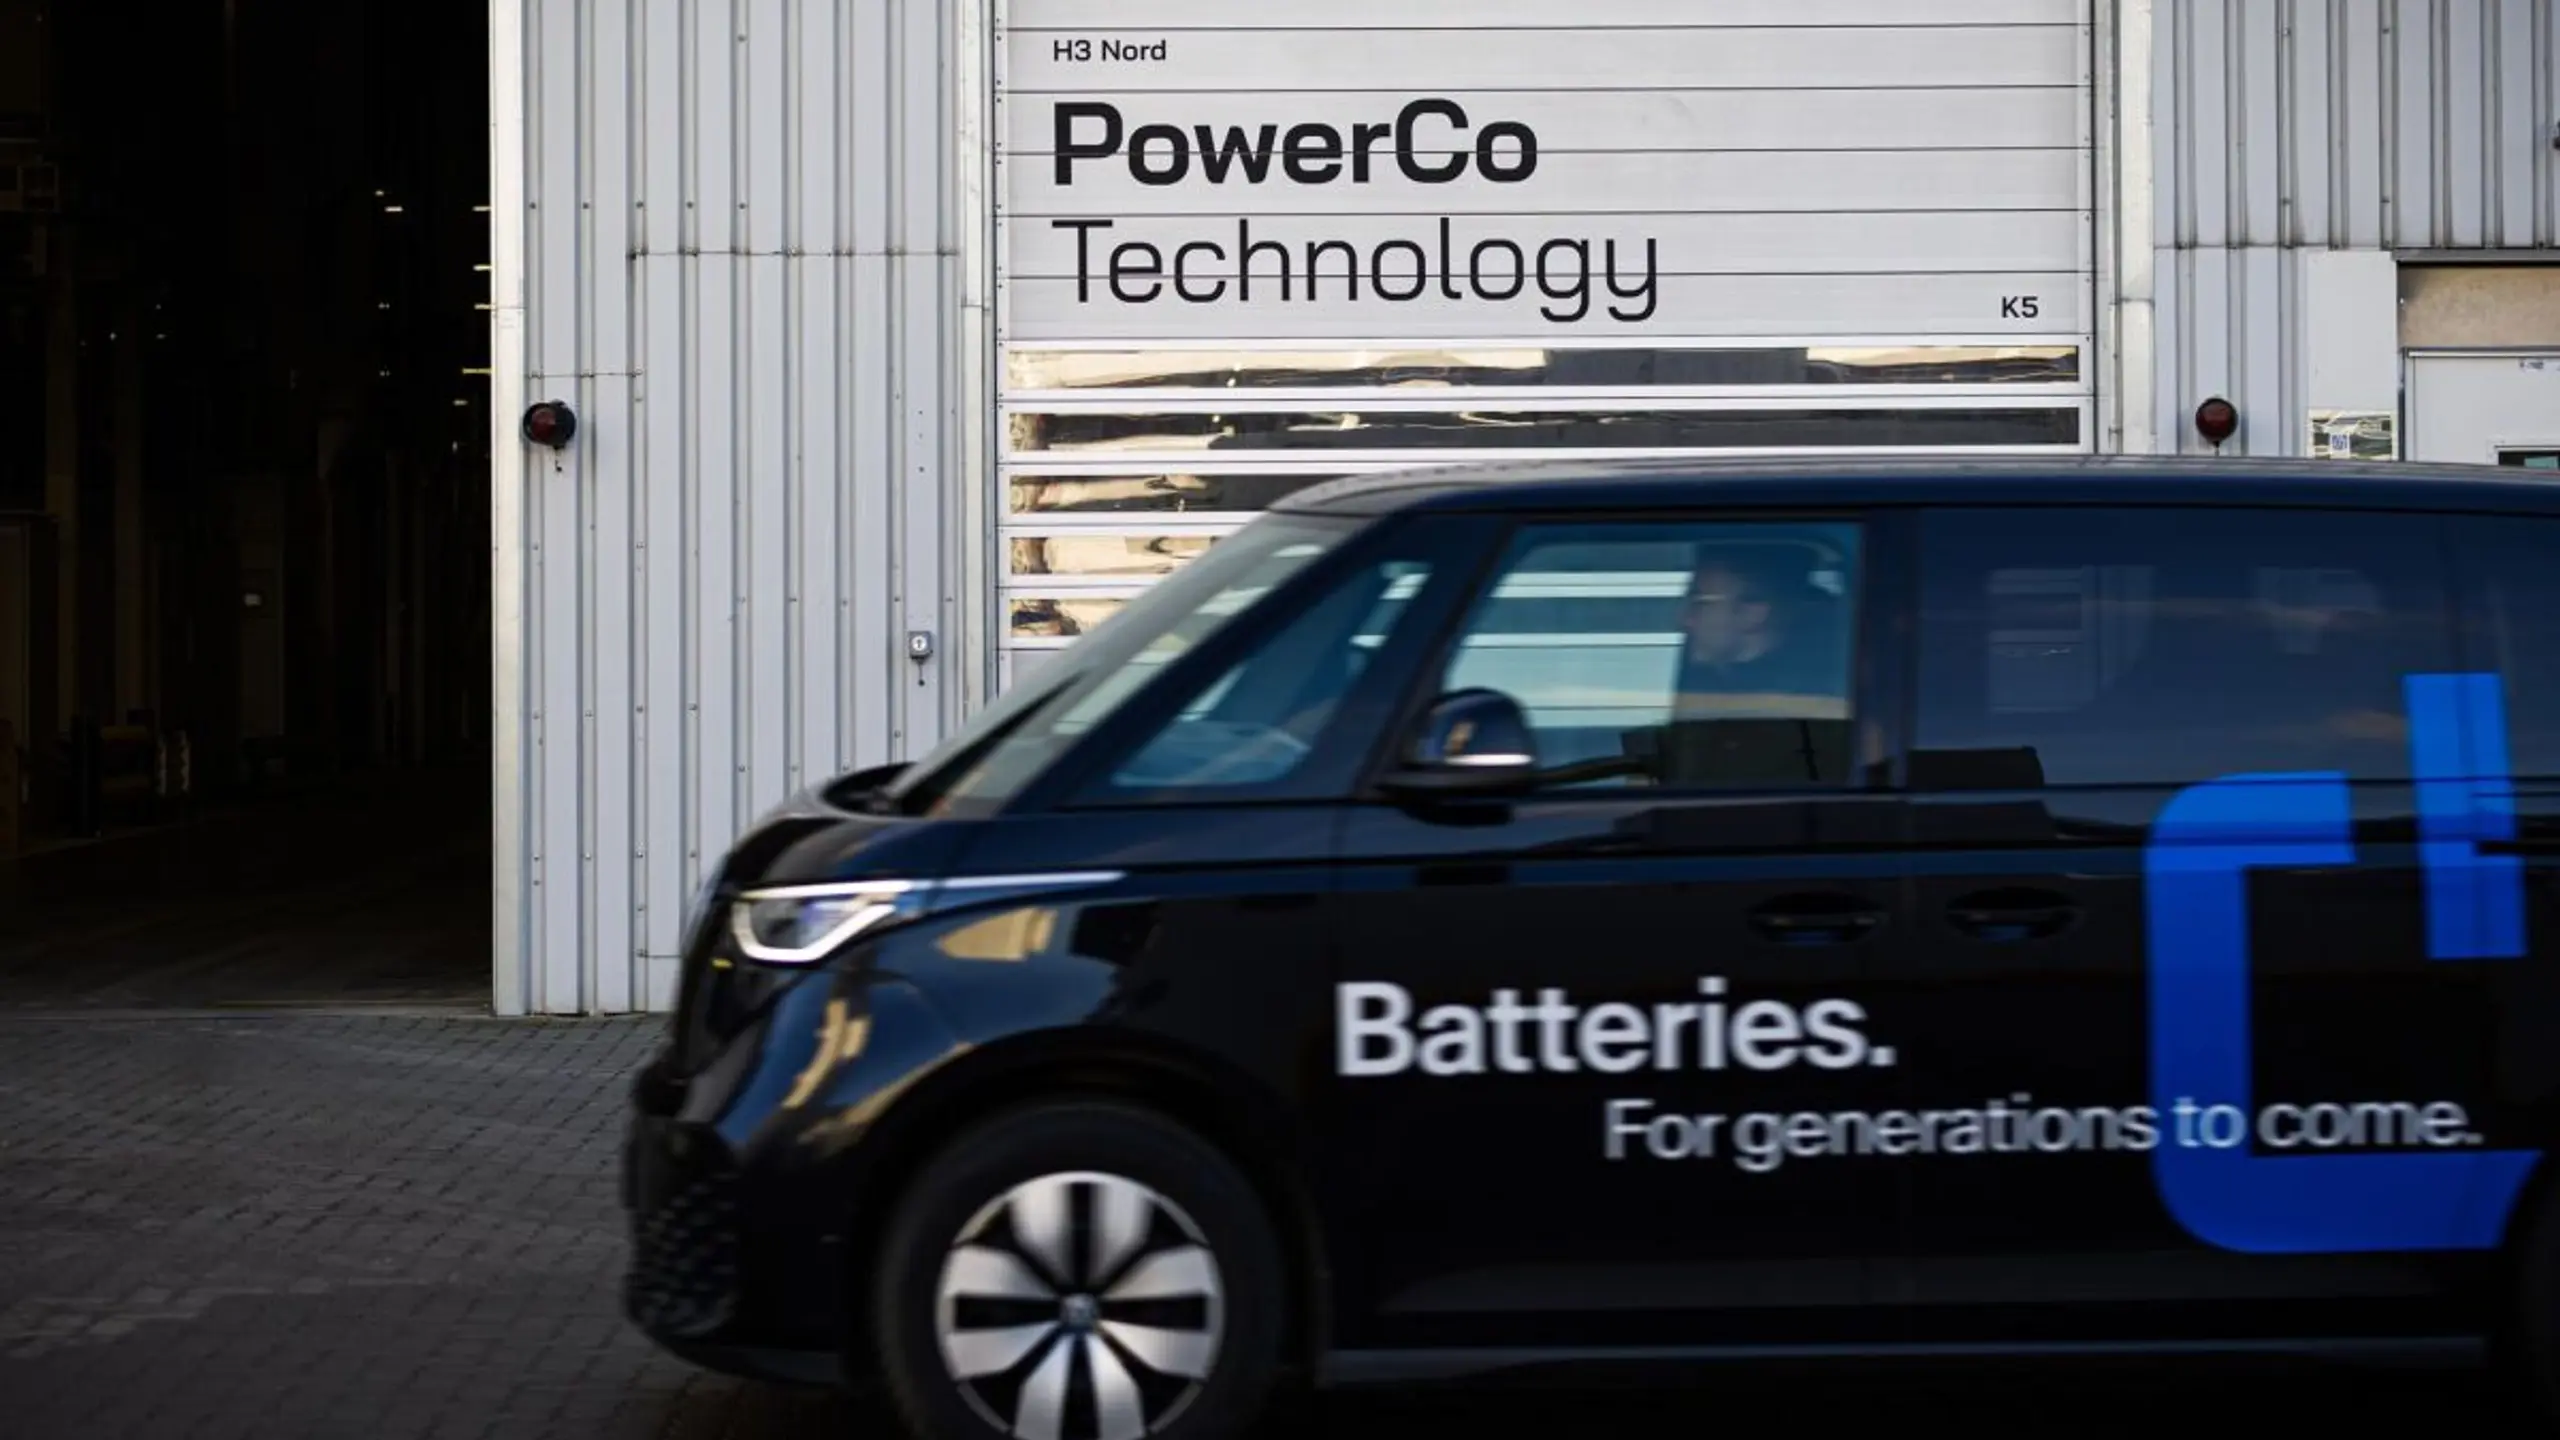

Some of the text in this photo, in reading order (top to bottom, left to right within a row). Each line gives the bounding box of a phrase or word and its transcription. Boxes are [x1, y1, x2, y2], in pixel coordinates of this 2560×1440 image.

[1053, 38, 1166, 61] H3 Nord
[1054, 98, 1538, 185] PowerCo
[1052, 217, 1657, 322] Technology
[2001, 295, 2039, 318] K5
[1336, 976, 1896, 1076] Batteries.
[1604, 1092, 2484, 1172] For generations to come.
